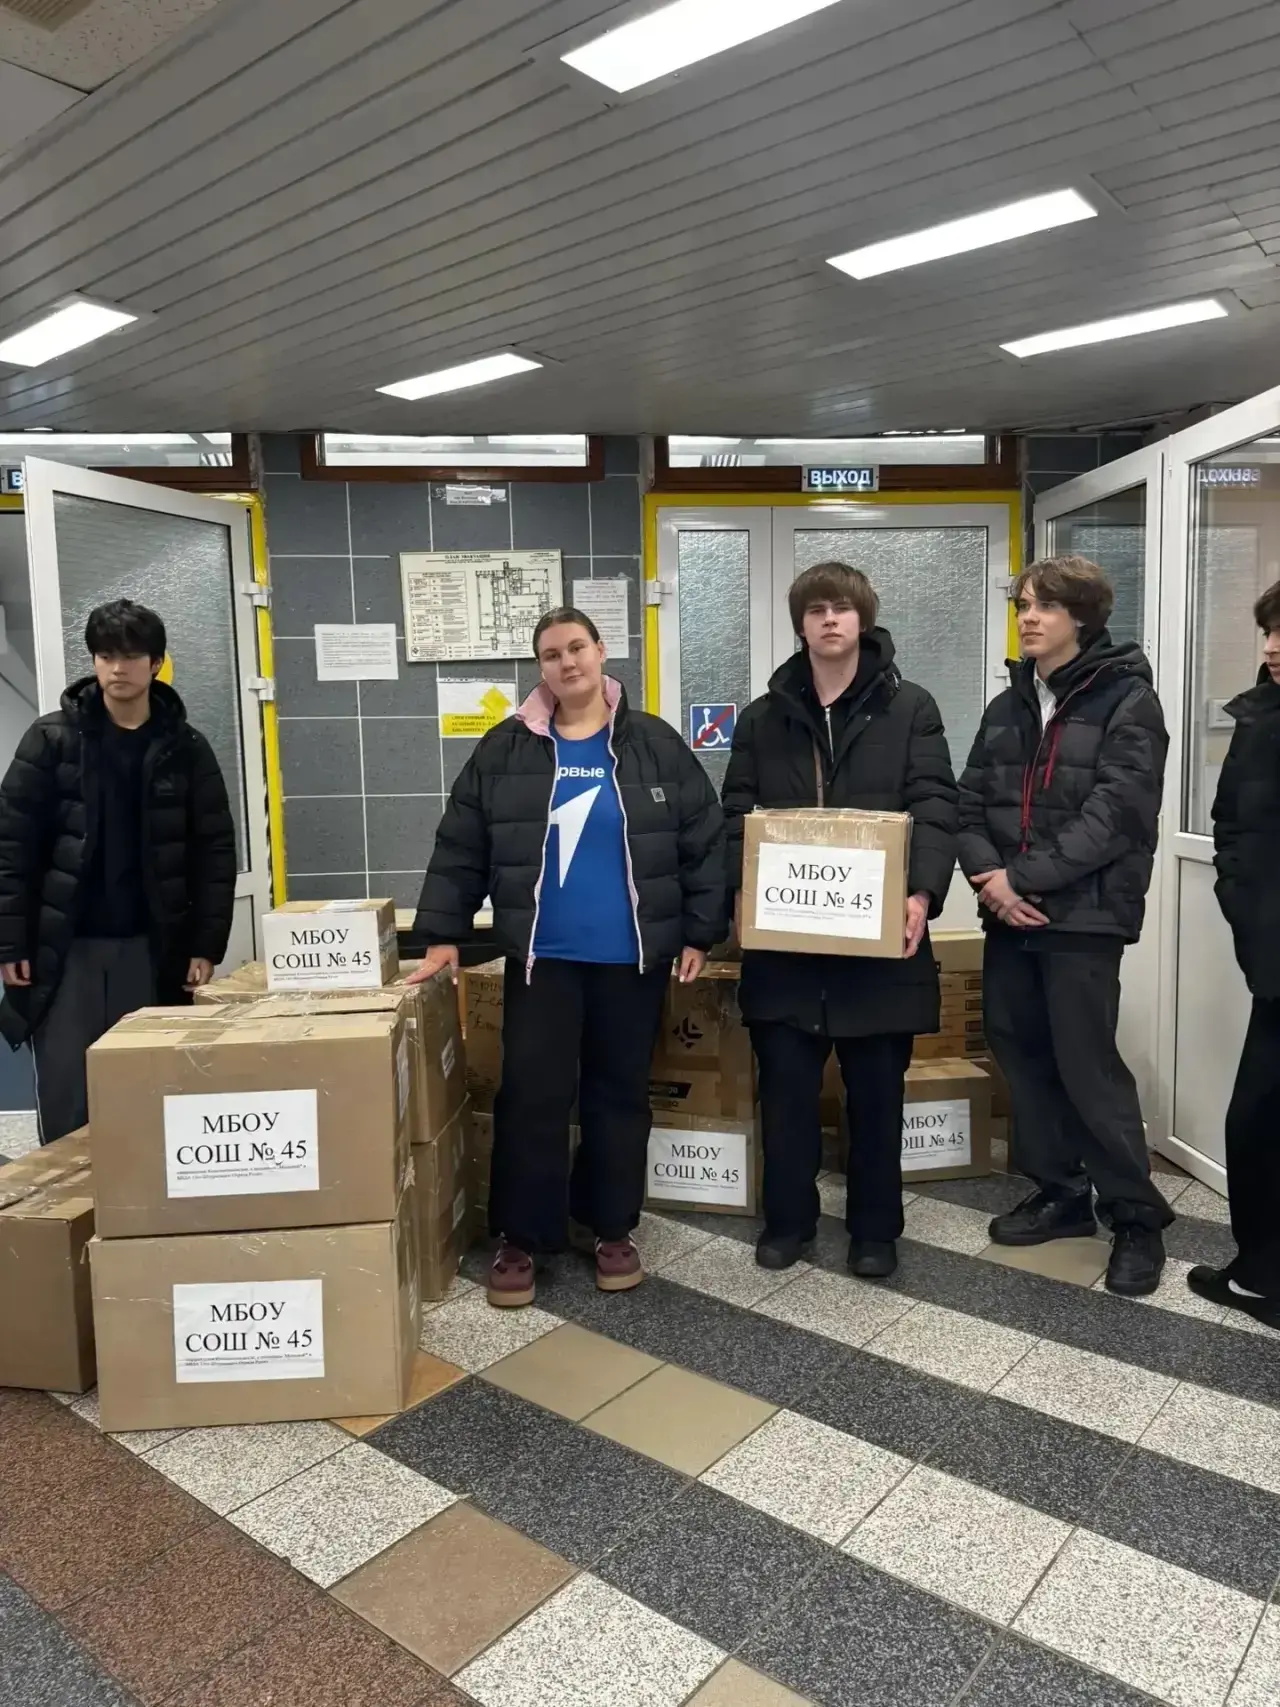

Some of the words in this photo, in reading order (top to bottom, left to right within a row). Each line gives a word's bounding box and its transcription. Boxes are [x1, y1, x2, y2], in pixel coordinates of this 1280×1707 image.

[810, 469, 871, 485] ВЫХОД
[558, 766, 605, 780] рвые
[788, 863, 852, 882] МБОУ
[765, 886, 817, 906] СОШ
[823, 890, 845, 908] №
[850, 893, 873, 910] 45
[290, 928, 349, 945] МБОУ
[272, 953, 321, 969] СОШ
[327, 952, 347, 967] №
[352, 950, 372, 966] 45
[202, 1112, 280, 1134] МБОУ
[902, 1113, 948, 1130] МБОУ
[902, 1135, 924, 1150] ОШ
[929, 1134, 944, 1147] №
[948, 1131, 964, 1145] 45
[176, 1143, 241, 1165] СОШ
[248, 1142, 275, 1161] №
[281, 1140, 307, 1159] 45
[671, 1144, 723, 1160] МБОУ
[654, 1162, 695, 1179] СОШ
[700, 1166, 717, 1181] №
[721, 1168, 739, 1183] 45
[209, 1301, 286, 1322] МБОУ
[185, 1332, 247, 1352] СОШ
[254, 1331, 280, 1350] №
[286, 1329, 312, 1348] 45
